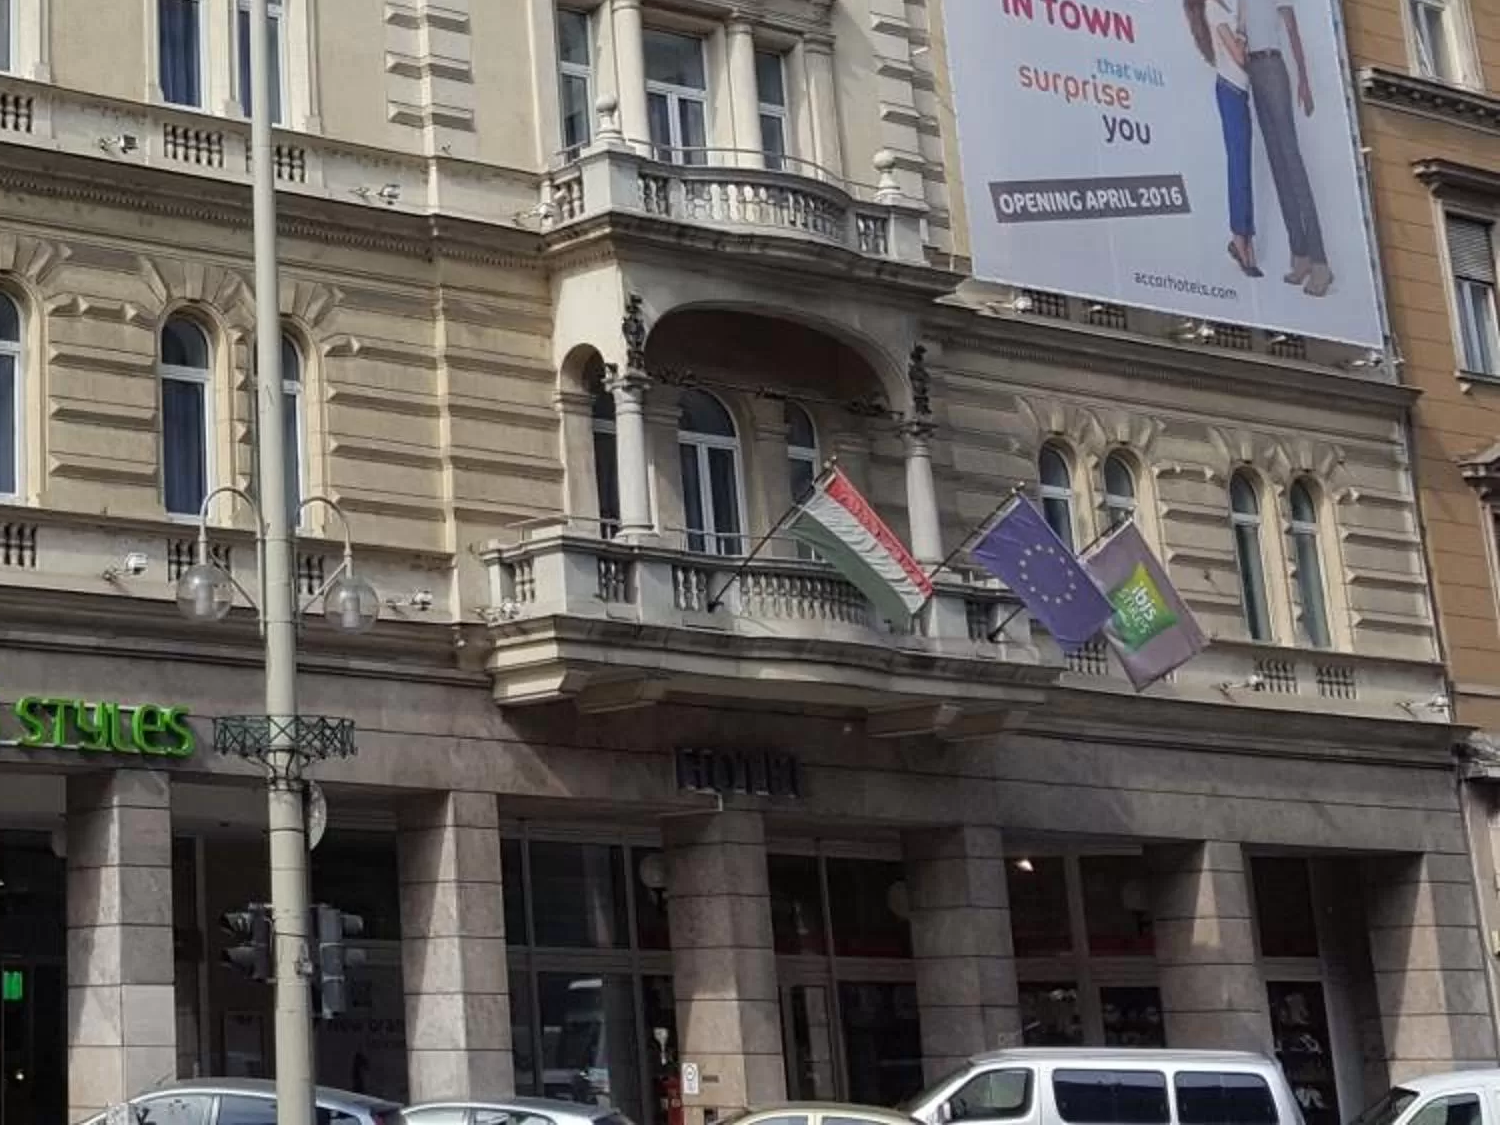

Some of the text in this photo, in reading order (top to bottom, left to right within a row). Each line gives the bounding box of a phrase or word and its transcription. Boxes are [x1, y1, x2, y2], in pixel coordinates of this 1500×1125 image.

[1018, 64, 1131, 109] surprise
[1097, 58, 1166, 88] that will
[1102, 114, 1151, 145] you
[999, 185, 1183, 214] OPENING APRIL 2016
[1134, 271, 1237, 300] accorhotels.com
[1131, 580, 1157, 621] ibis
